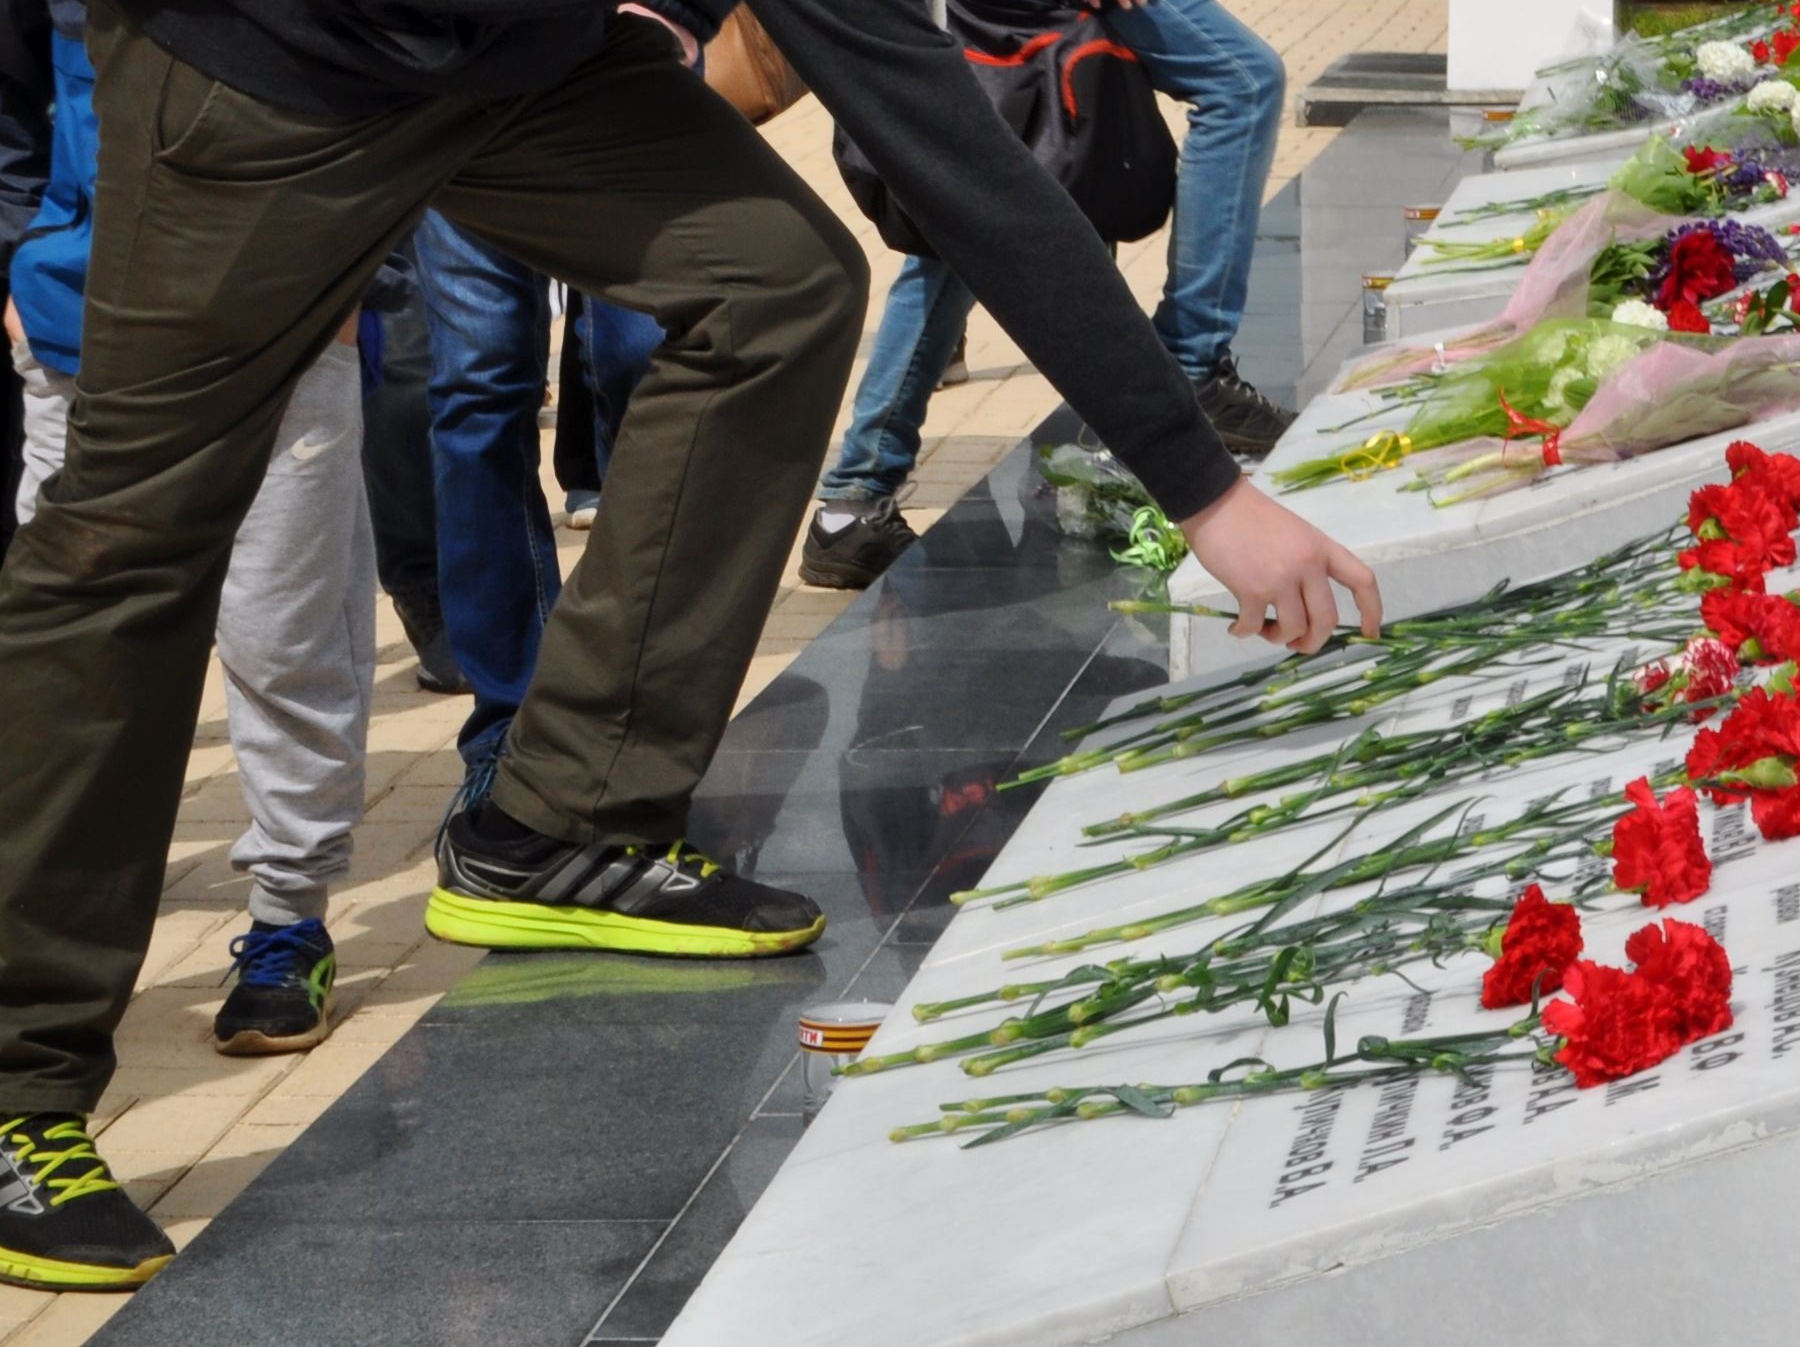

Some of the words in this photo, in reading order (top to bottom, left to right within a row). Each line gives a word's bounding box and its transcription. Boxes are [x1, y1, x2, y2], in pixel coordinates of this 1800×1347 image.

[1366, 1073, 1421, 1146] уличкин
[1438, 1106, 1499, 1151] Ф.А.
[1268, 1160, 1334, 1209] В.А.
